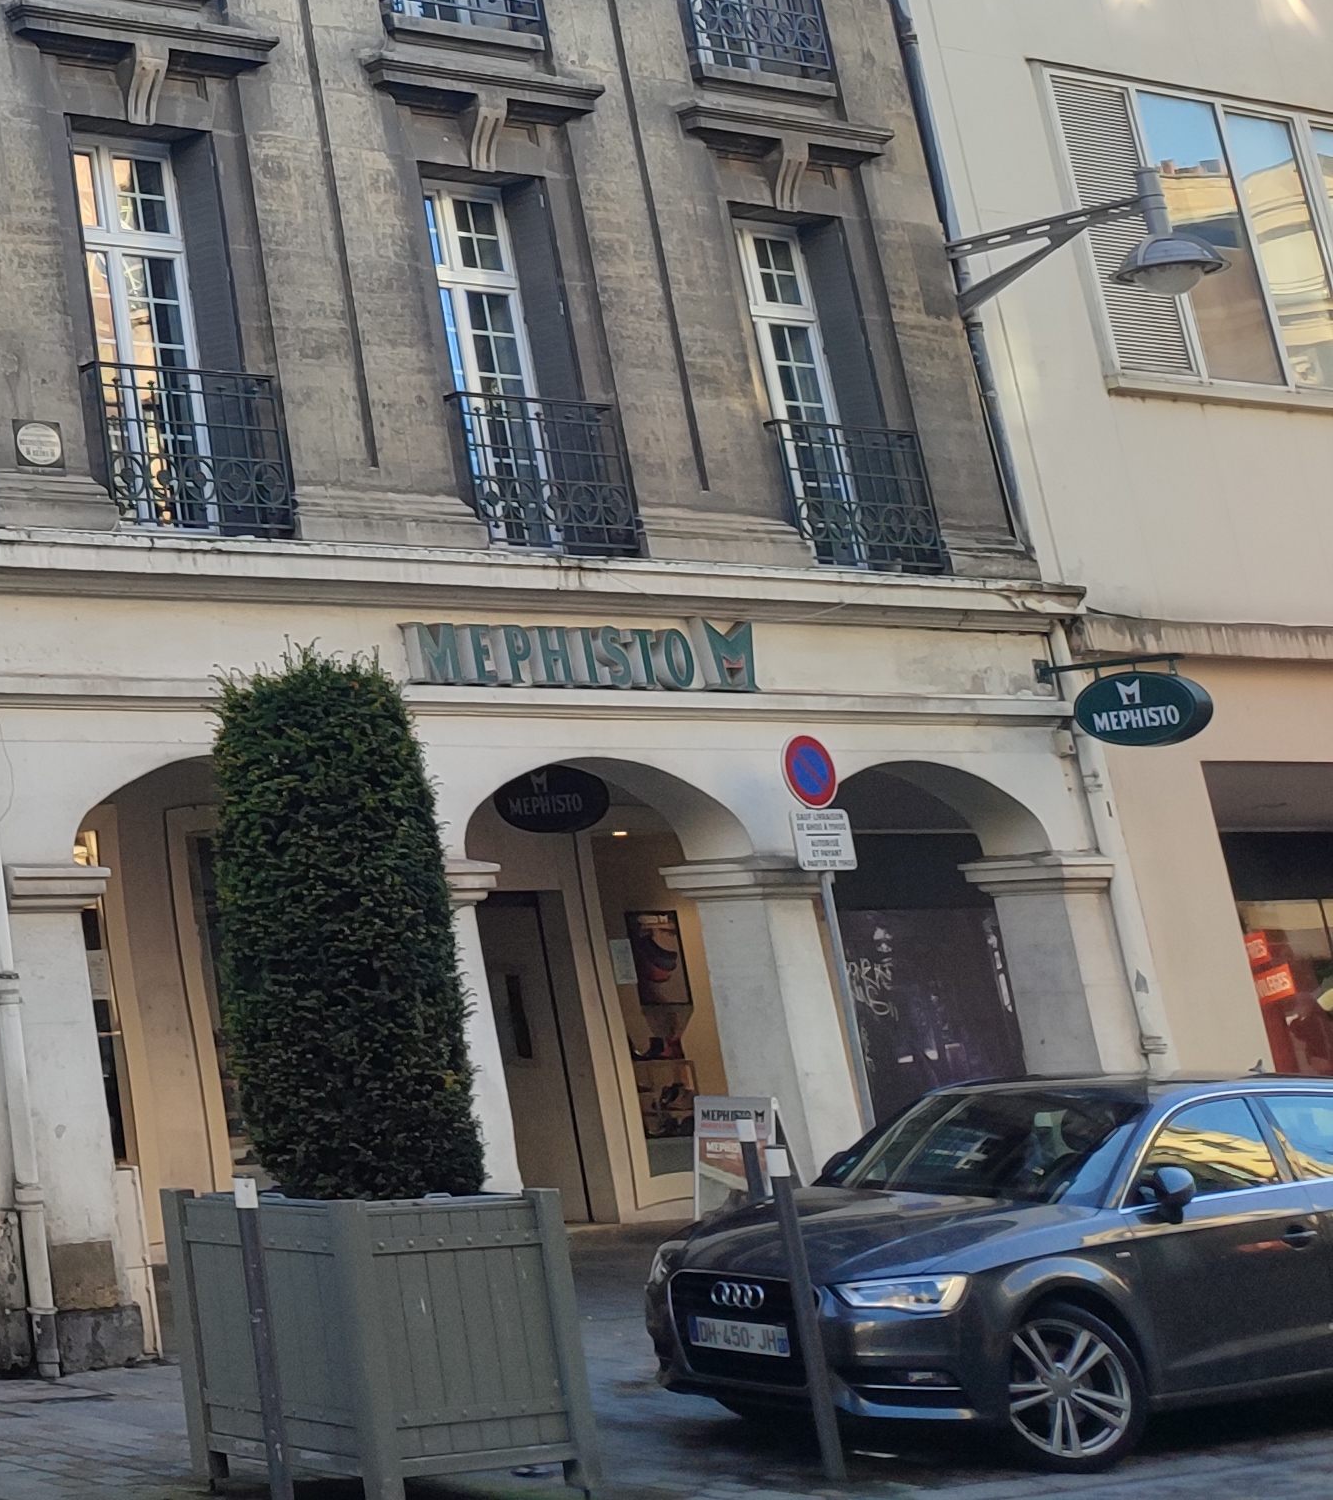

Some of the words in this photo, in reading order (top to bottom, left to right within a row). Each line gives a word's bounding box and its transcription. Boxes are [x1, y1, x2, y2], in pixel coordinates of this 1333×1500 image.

[397, 621, 696, 691] MEPHISTO
[1092, 704, 1181, 733] MEPHISTO
[507, 792, 583, 817] MEPHISTO
[698, 1321, 778, 1351] DH-450-JH
